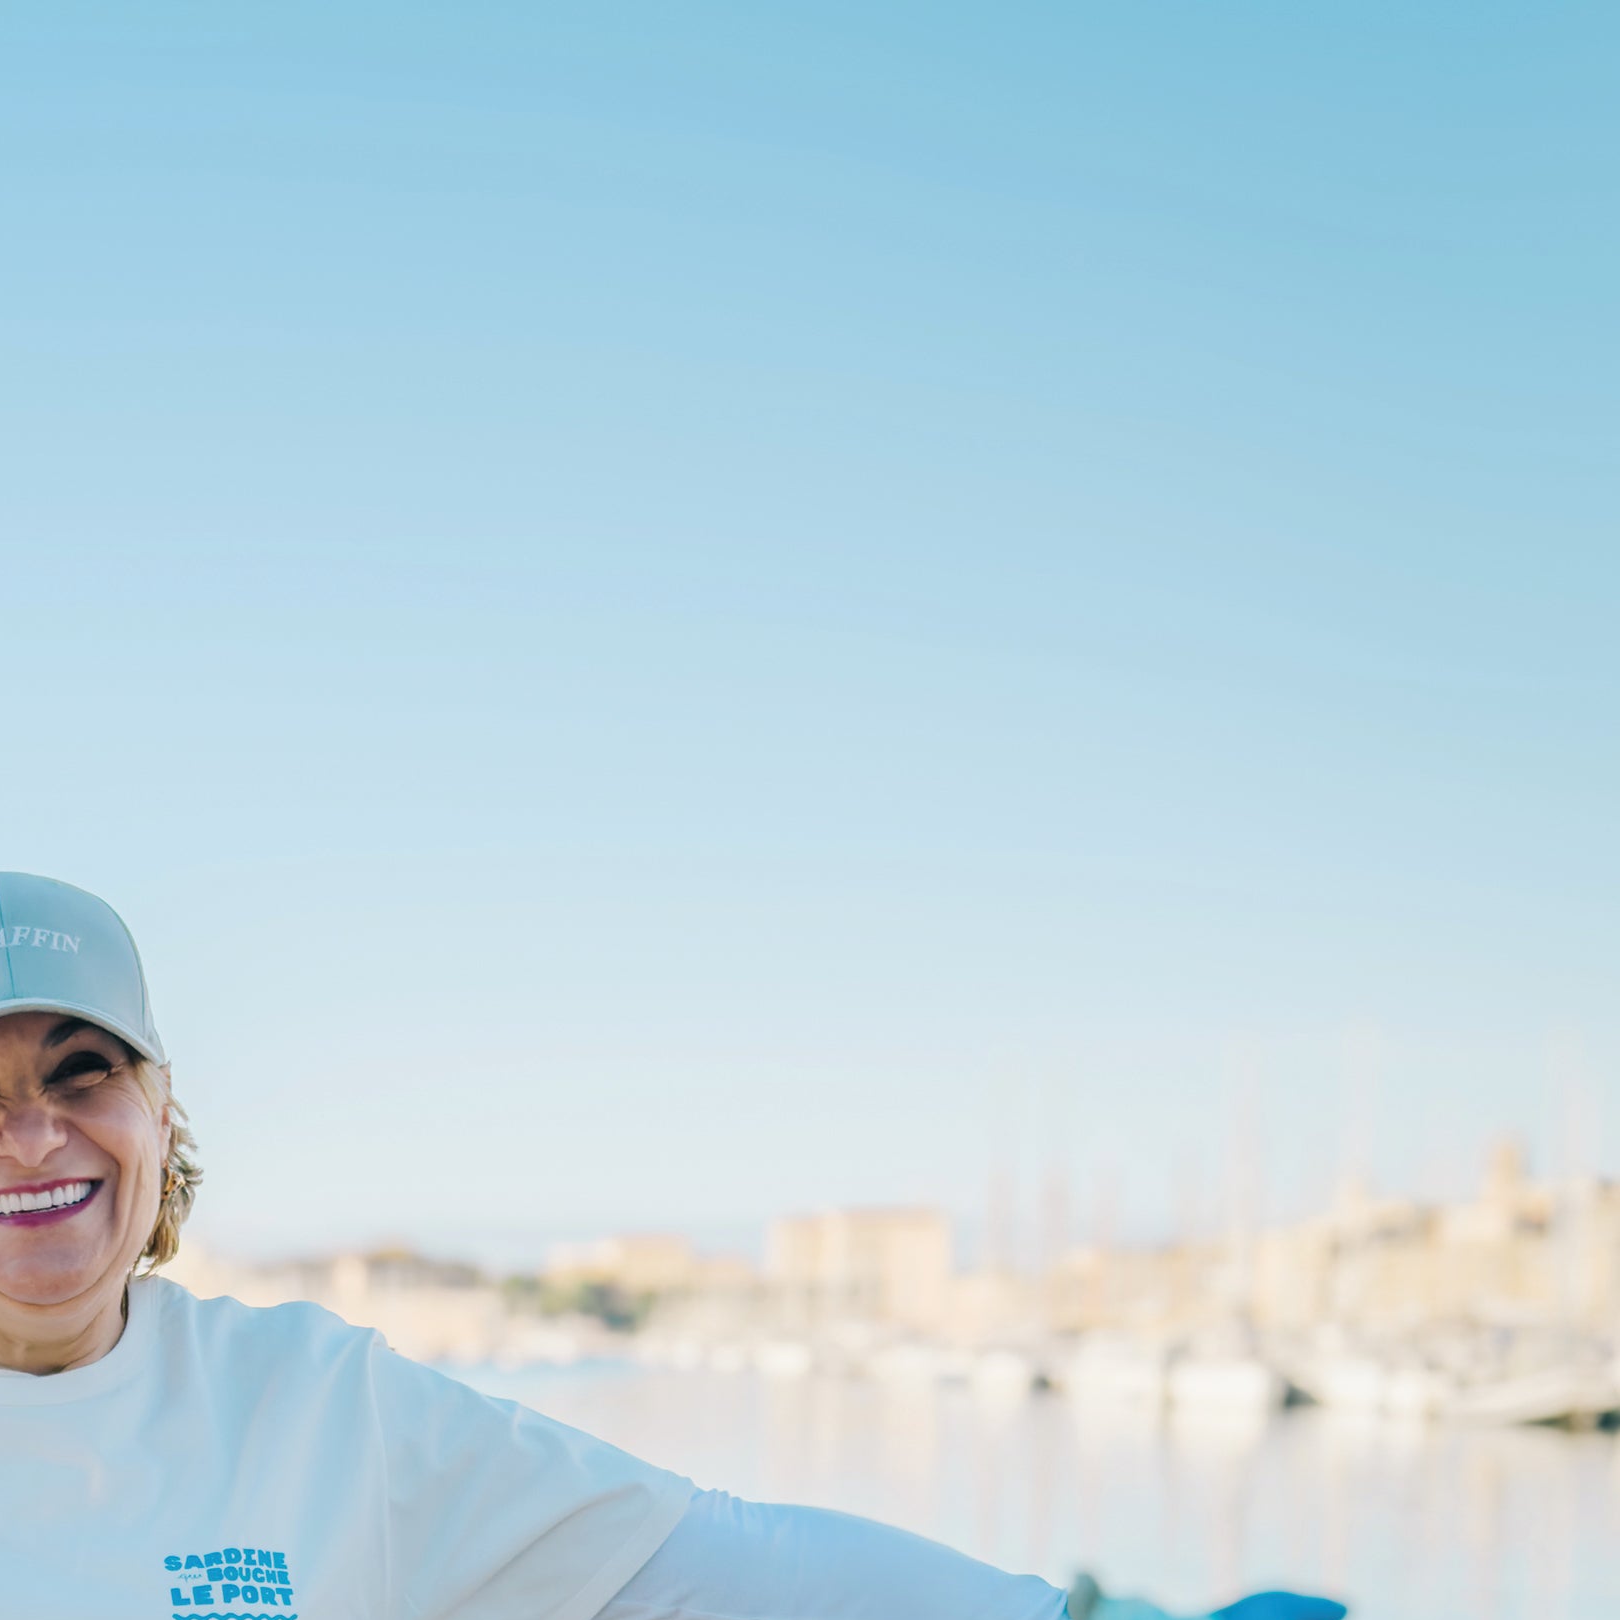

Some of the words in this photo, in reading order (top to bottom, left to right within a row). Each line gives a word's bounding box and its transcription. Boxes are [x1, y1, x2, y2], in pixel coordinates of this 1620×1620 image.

[164, 1548, 288, 1571] SARDINE
[207, 1566, 290, 1585] BOUCHE
[171, 1584, 214, 1606] LE
[221, 1584, 294, 1606] PORT
